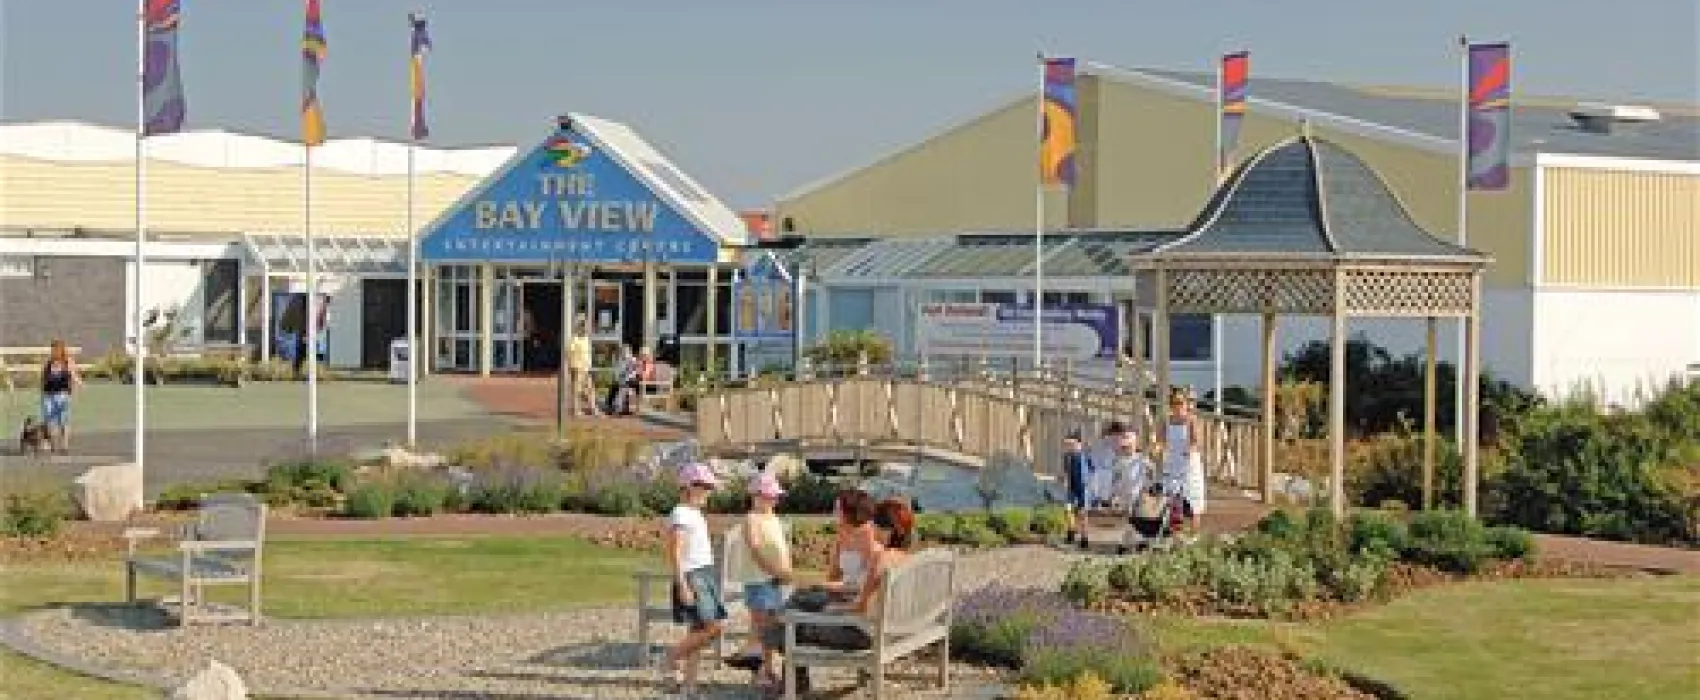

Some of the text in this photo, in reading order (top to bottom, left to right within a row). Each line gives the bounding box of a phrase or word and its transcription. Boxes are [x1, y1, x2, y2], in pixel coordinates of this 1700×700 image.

[538, 173, 597, 195] THE
[475, 201, 657, 231] BAY VIEW
[444, 237, 604, 251] ENTERTAINMENT
